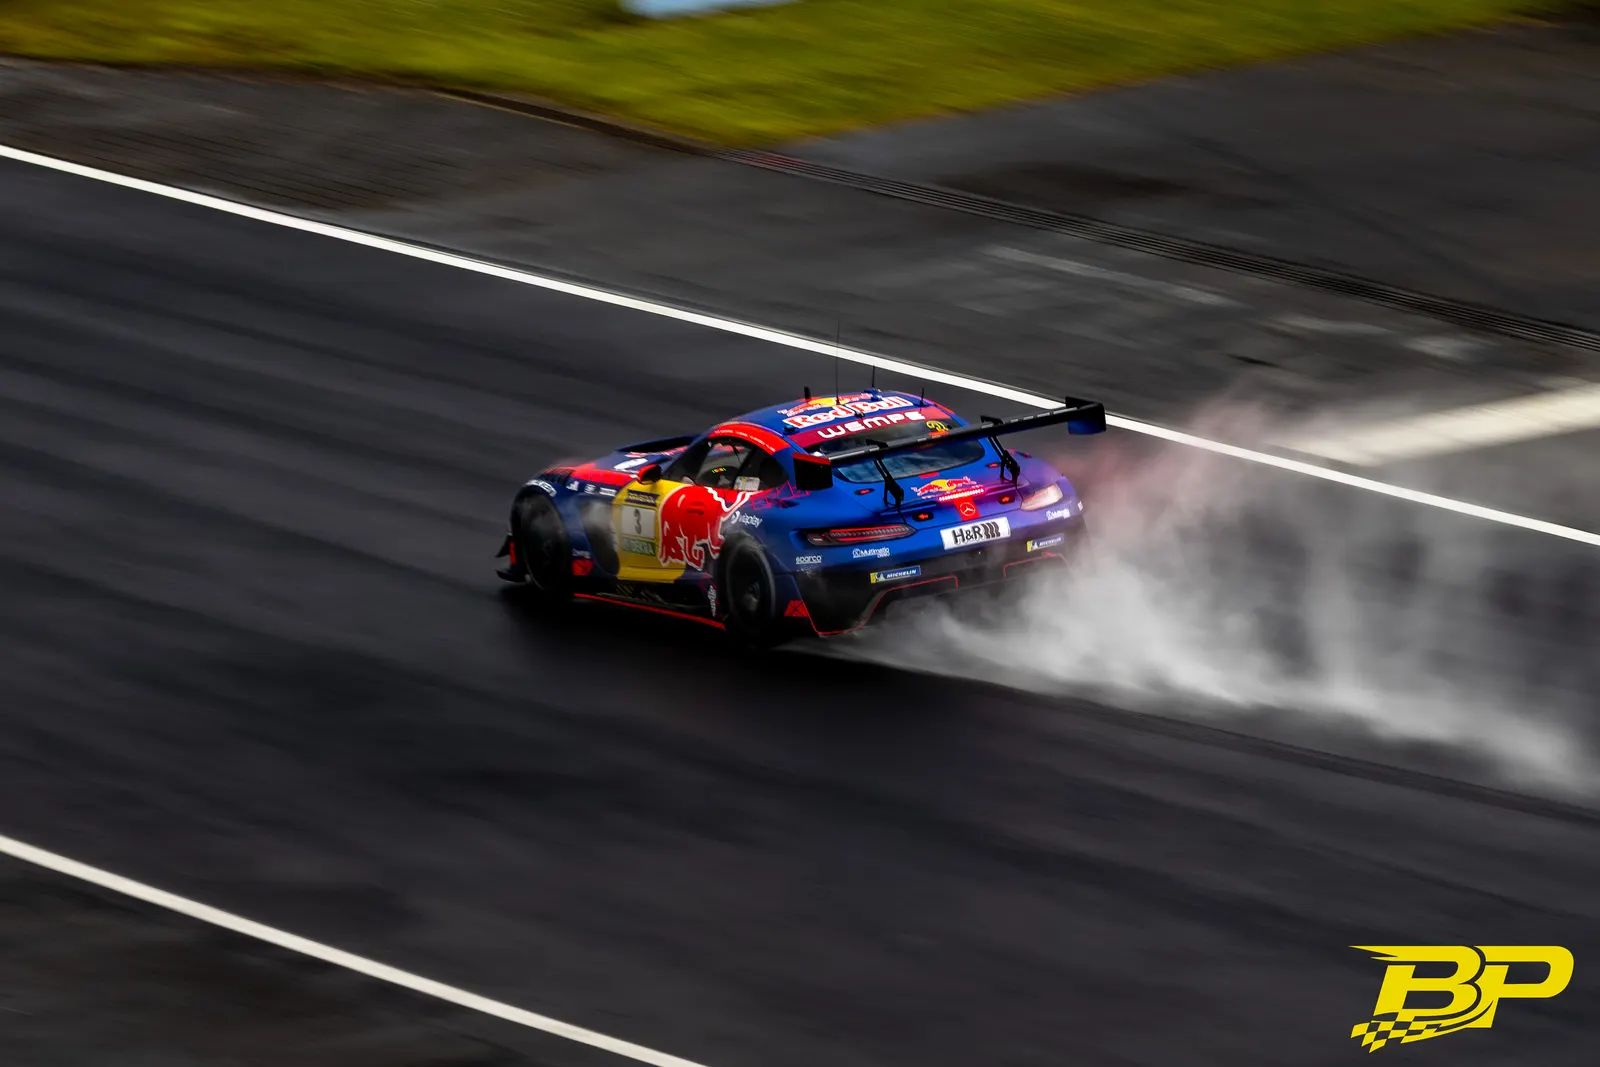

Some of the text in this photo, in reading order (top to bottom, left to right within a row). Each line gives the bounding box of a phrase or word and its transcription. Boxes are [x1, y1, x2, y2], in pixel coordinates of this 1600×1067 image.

[782, 396, 914, 428] Red Bull
[817, 411, 926, 439] WEMPE
[633, 508, 642, 535] 3
[951, 525, 983, 545] H&R
[795, 555, 822, 565] sparco
[886, 569, 917, 579] MICHELIN
